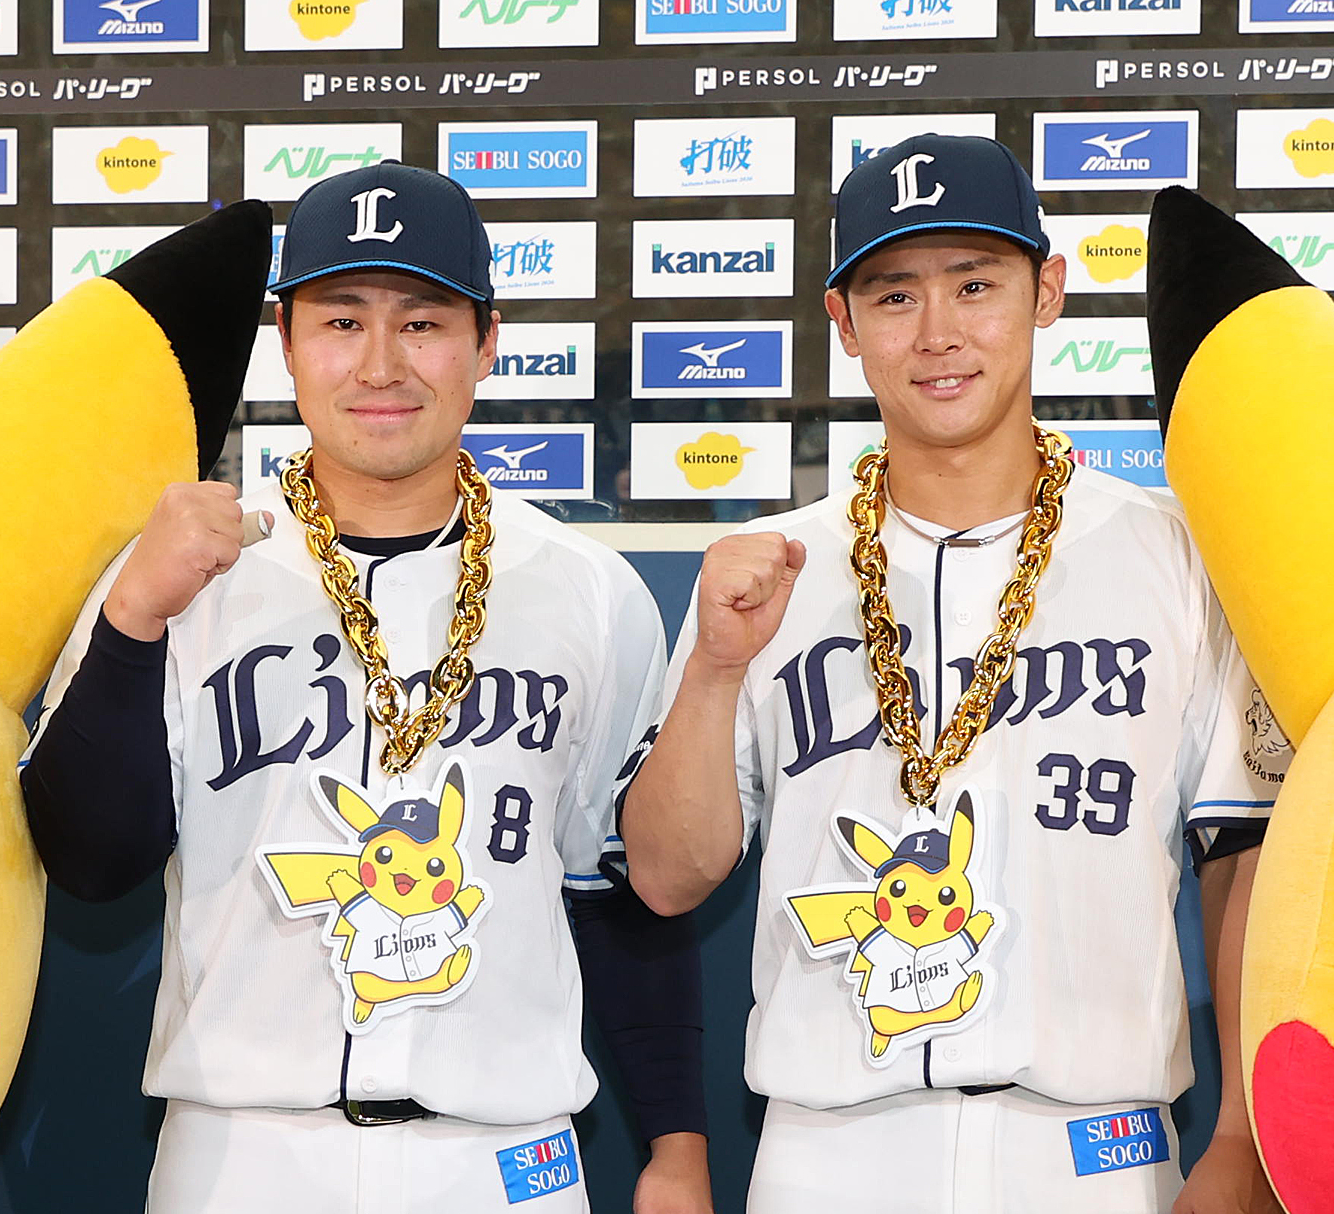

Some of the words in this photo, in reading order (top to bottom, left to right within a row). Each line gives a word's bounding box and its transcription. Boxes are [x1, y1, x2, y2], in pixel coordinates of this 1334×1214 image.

[297, 3, 351, 15] kintone
[98, 20, 164, 35] MIZUNO
[723, 68, 820, 86] PERSOL
[1124, 61, 1225, 79] PERSOL
[330, 75, 426, 93] PERSOL
[104, 153, 157, 170] kintone
[453, 149, 520, 171] SEIBU
[527, 148, 583, 170] SOGO
[679, 132, 754, 176] 打破
[1080, 154, 1150, 171] MIZUNO
[889, 153, 946, 213] L
[347, 187, 404, 244] L
[651, 242, 775, 275] kanzai
[1086, 244, 1142, 257] kintone
[493, 345, 577, 376] nzai
[1050, 340, 1152, 373] ベルー
[678, 363, 746, 380] MIZUNO
[683, 450, 738, 465] kintone
[1121, 448, 1163, 469] SOG
[1034, 752, 1136, 836] 39
[401, 803, 418, 823] L
[486, 784, 533, 864] 8
[913, 834, 930, 852] L
[1086, 1113, 1153, 1143] SEIBU
[514, 1136, 568, 1171] SEIBU
[1097, 1140, 1153, 1169] SOGO
[527, 1163, 570, 1195] SOGO
